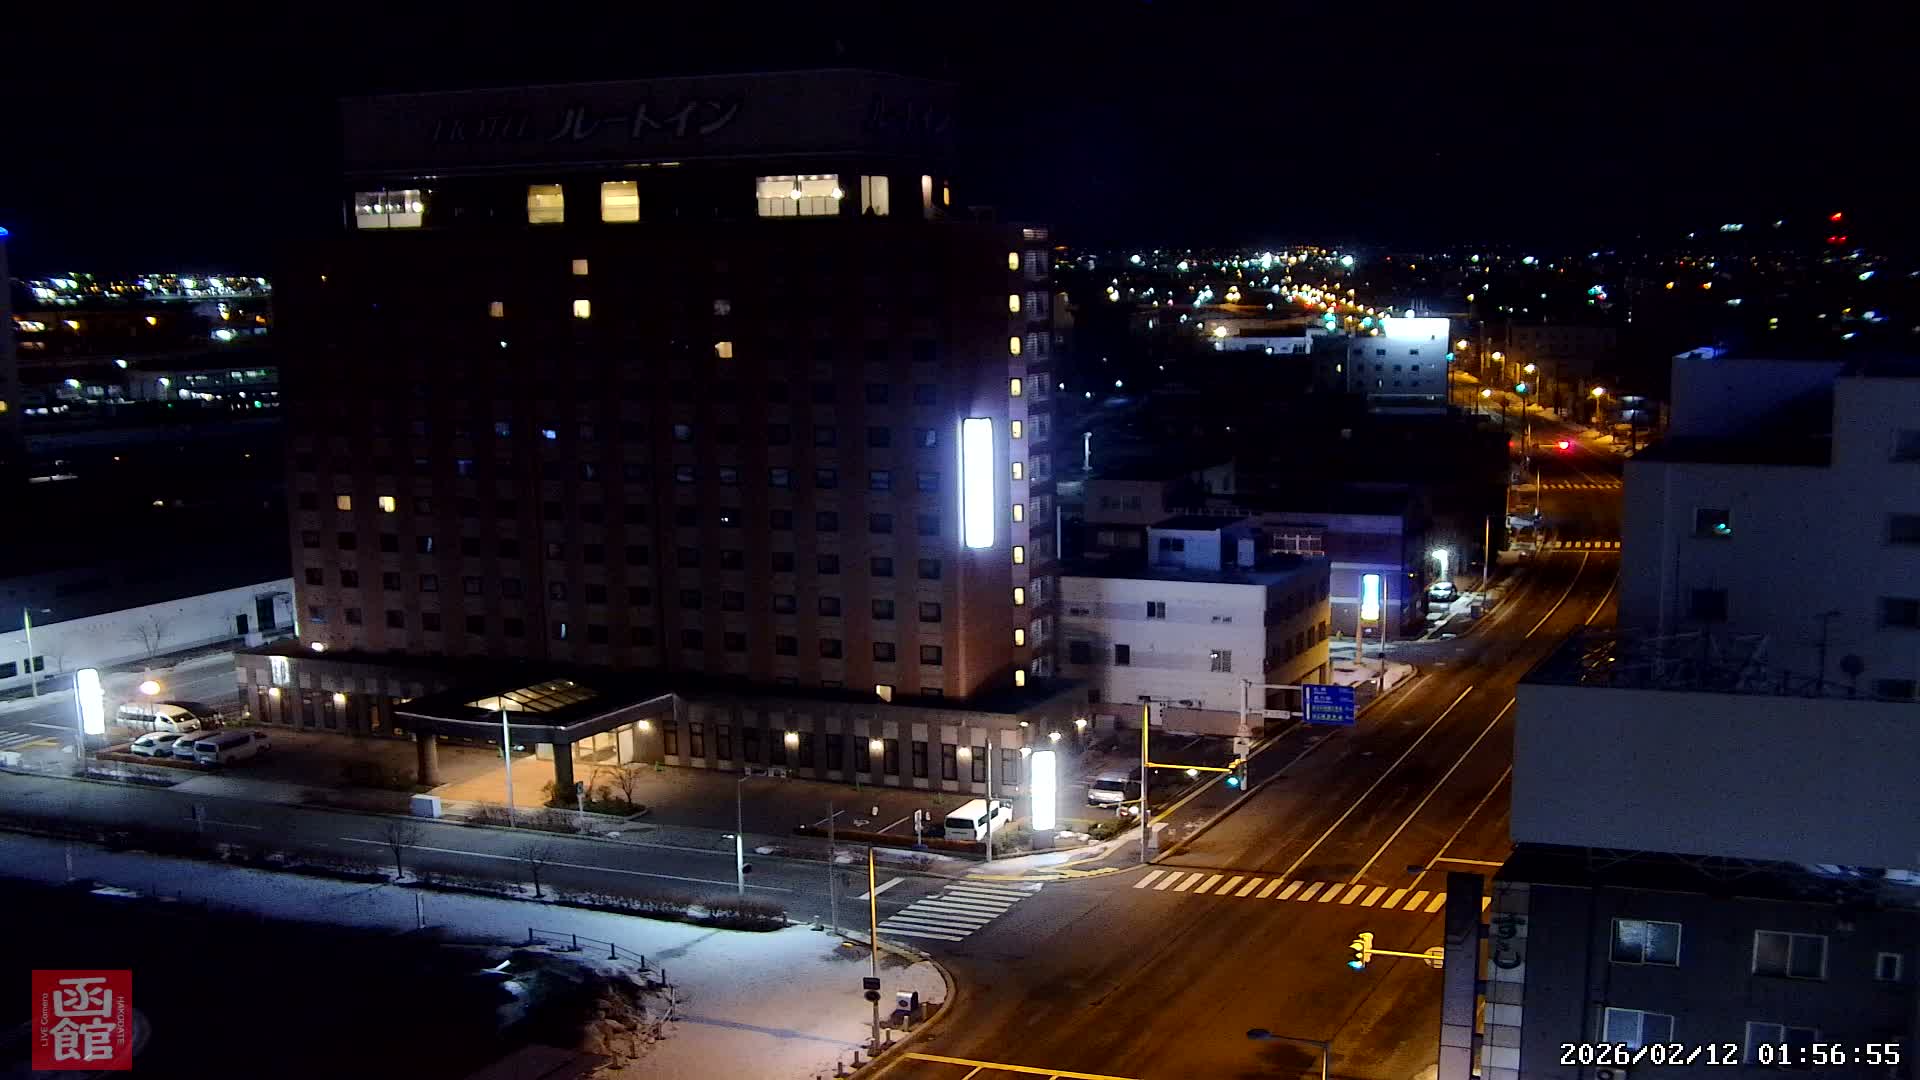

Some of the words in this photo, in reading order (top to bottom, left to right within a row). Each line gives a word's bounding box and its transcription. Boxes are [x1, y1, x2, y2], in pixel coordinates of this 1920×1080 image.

[545, 99, 742, 144] ルートイン
